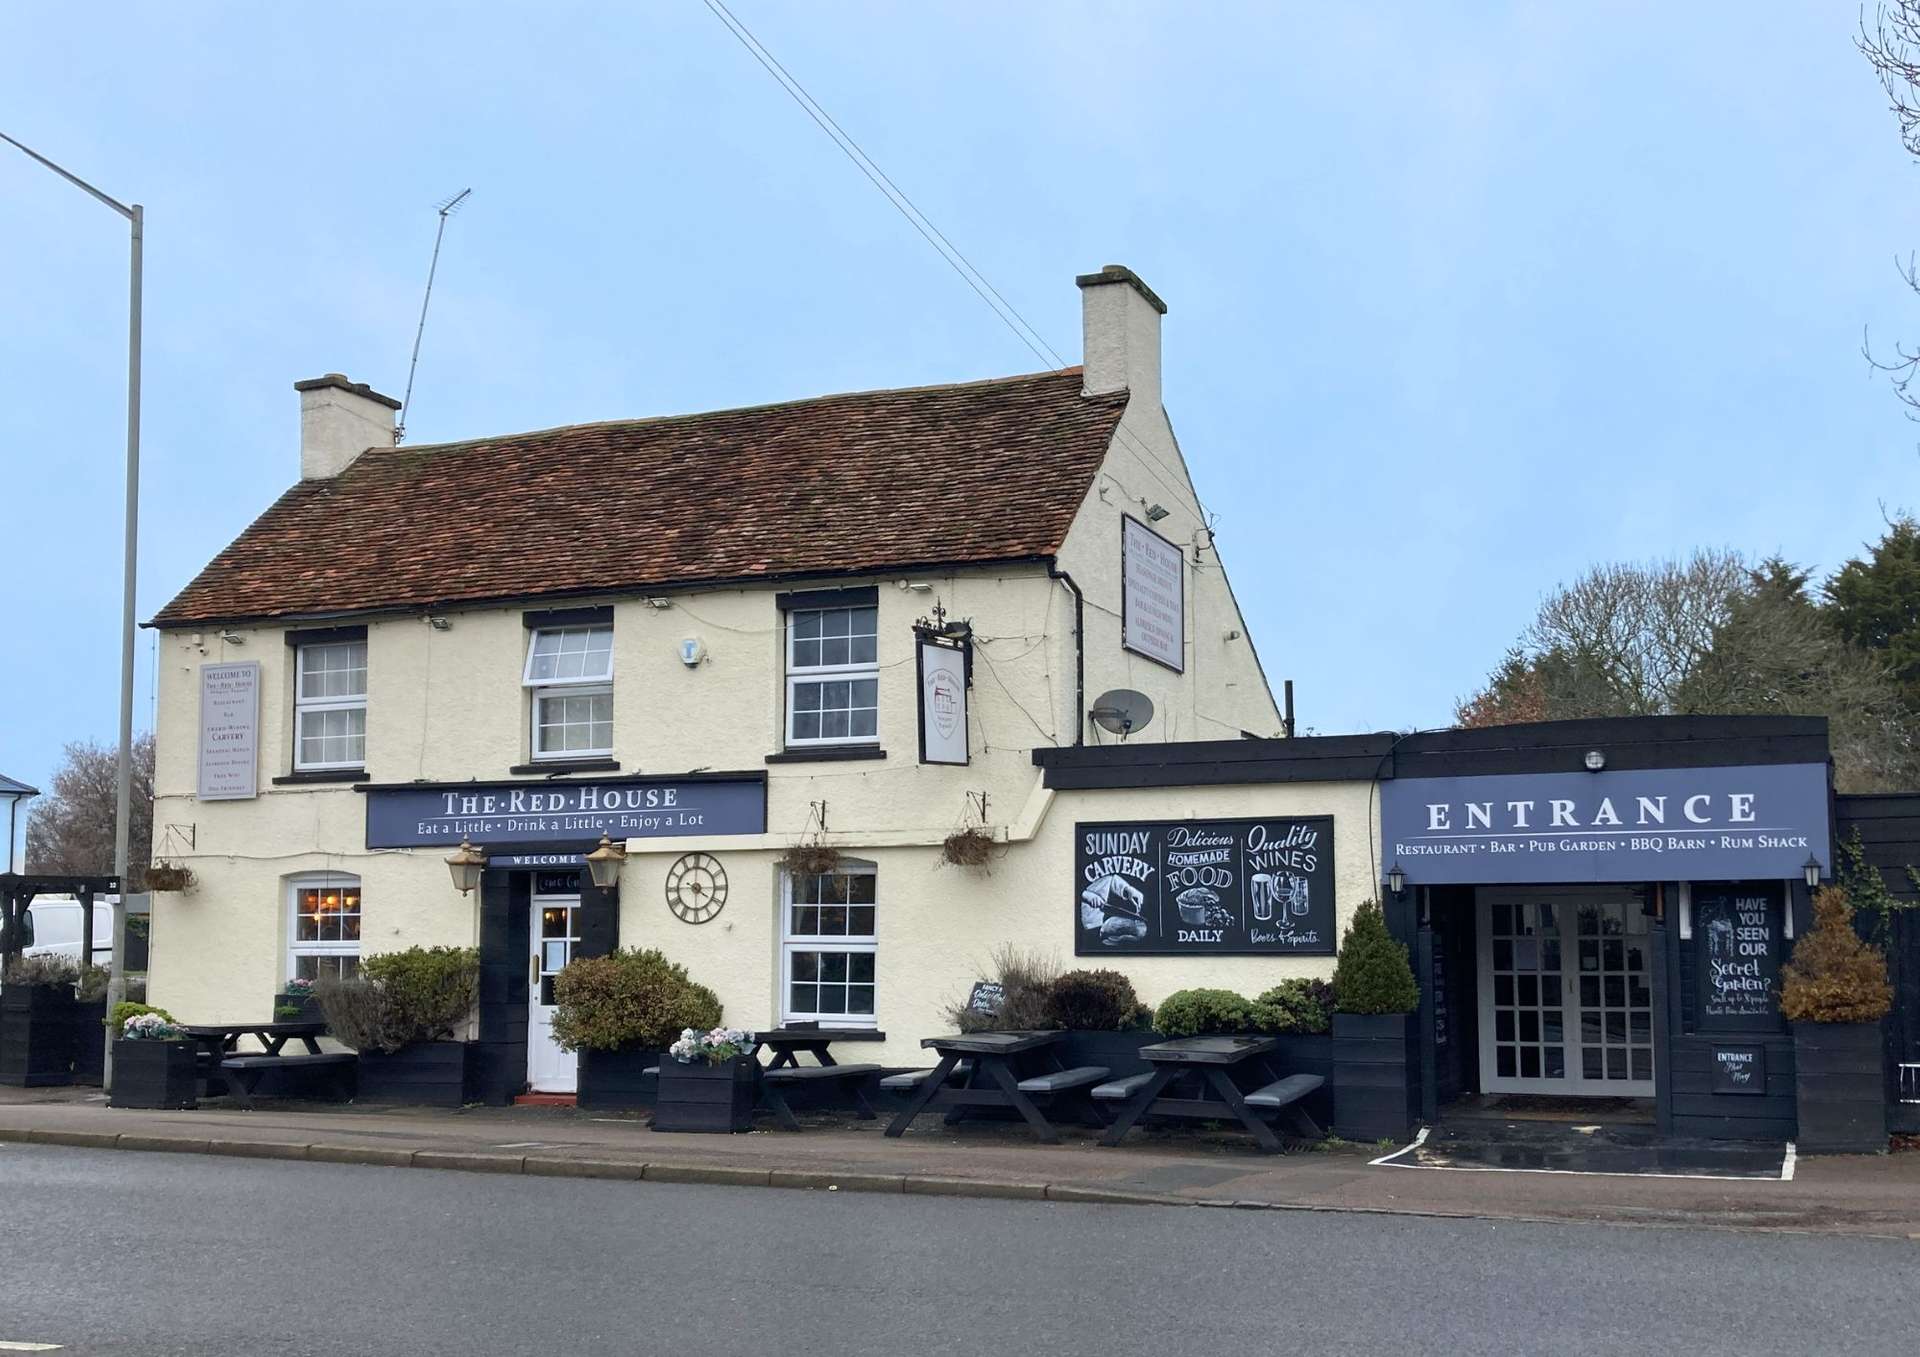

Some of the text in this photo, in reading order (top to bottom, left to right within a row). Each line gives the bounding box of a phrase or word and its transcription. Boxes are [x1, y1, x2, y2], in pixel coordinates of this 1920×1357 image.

[207, 670, 252, 680] WELCOME TO
[212, 733, 243, 741] CARVERY
[442, 787, 678, 815] THE RED HOUSE
[1426, 793, 1757, 831] ENTRANCE
[417, 813, 704, 835] Eat a Little Drink a Little Enjoy a Lot
[1085, 831, 1150, 856] SUNDAY
[1166, 827, 1234, 848] Delicious
[1246, 825, 1318, 852] Quality
[1396, 834, 1808, 856] RESTAURANT BAR PUB GARDEN BBQ BARN RUM SHACK
[513, 855, 577, 865] WELCOME
[1168, 850, 1231, 865] HOMEMADE
[1249, 850, 1317, 872] WINES
[1084, 855, 1155, 883] CARVERY
[1166, 866, 1233, 893] FOOD
[1736, 898, 1767, 911] HAVE
[1739, 912, 1765, 926] YOU
[1178, 929, 1223, 943] DAILY
[1737, 927, 1769, 941] SEEN
[1739, 942, 1768, 956] OUR
[1710, 958, 1760, 980] Secret
[1711, 976, 1771, 993] Garden?
[1717, 1052, 1753, 1063] ENTRANCE
